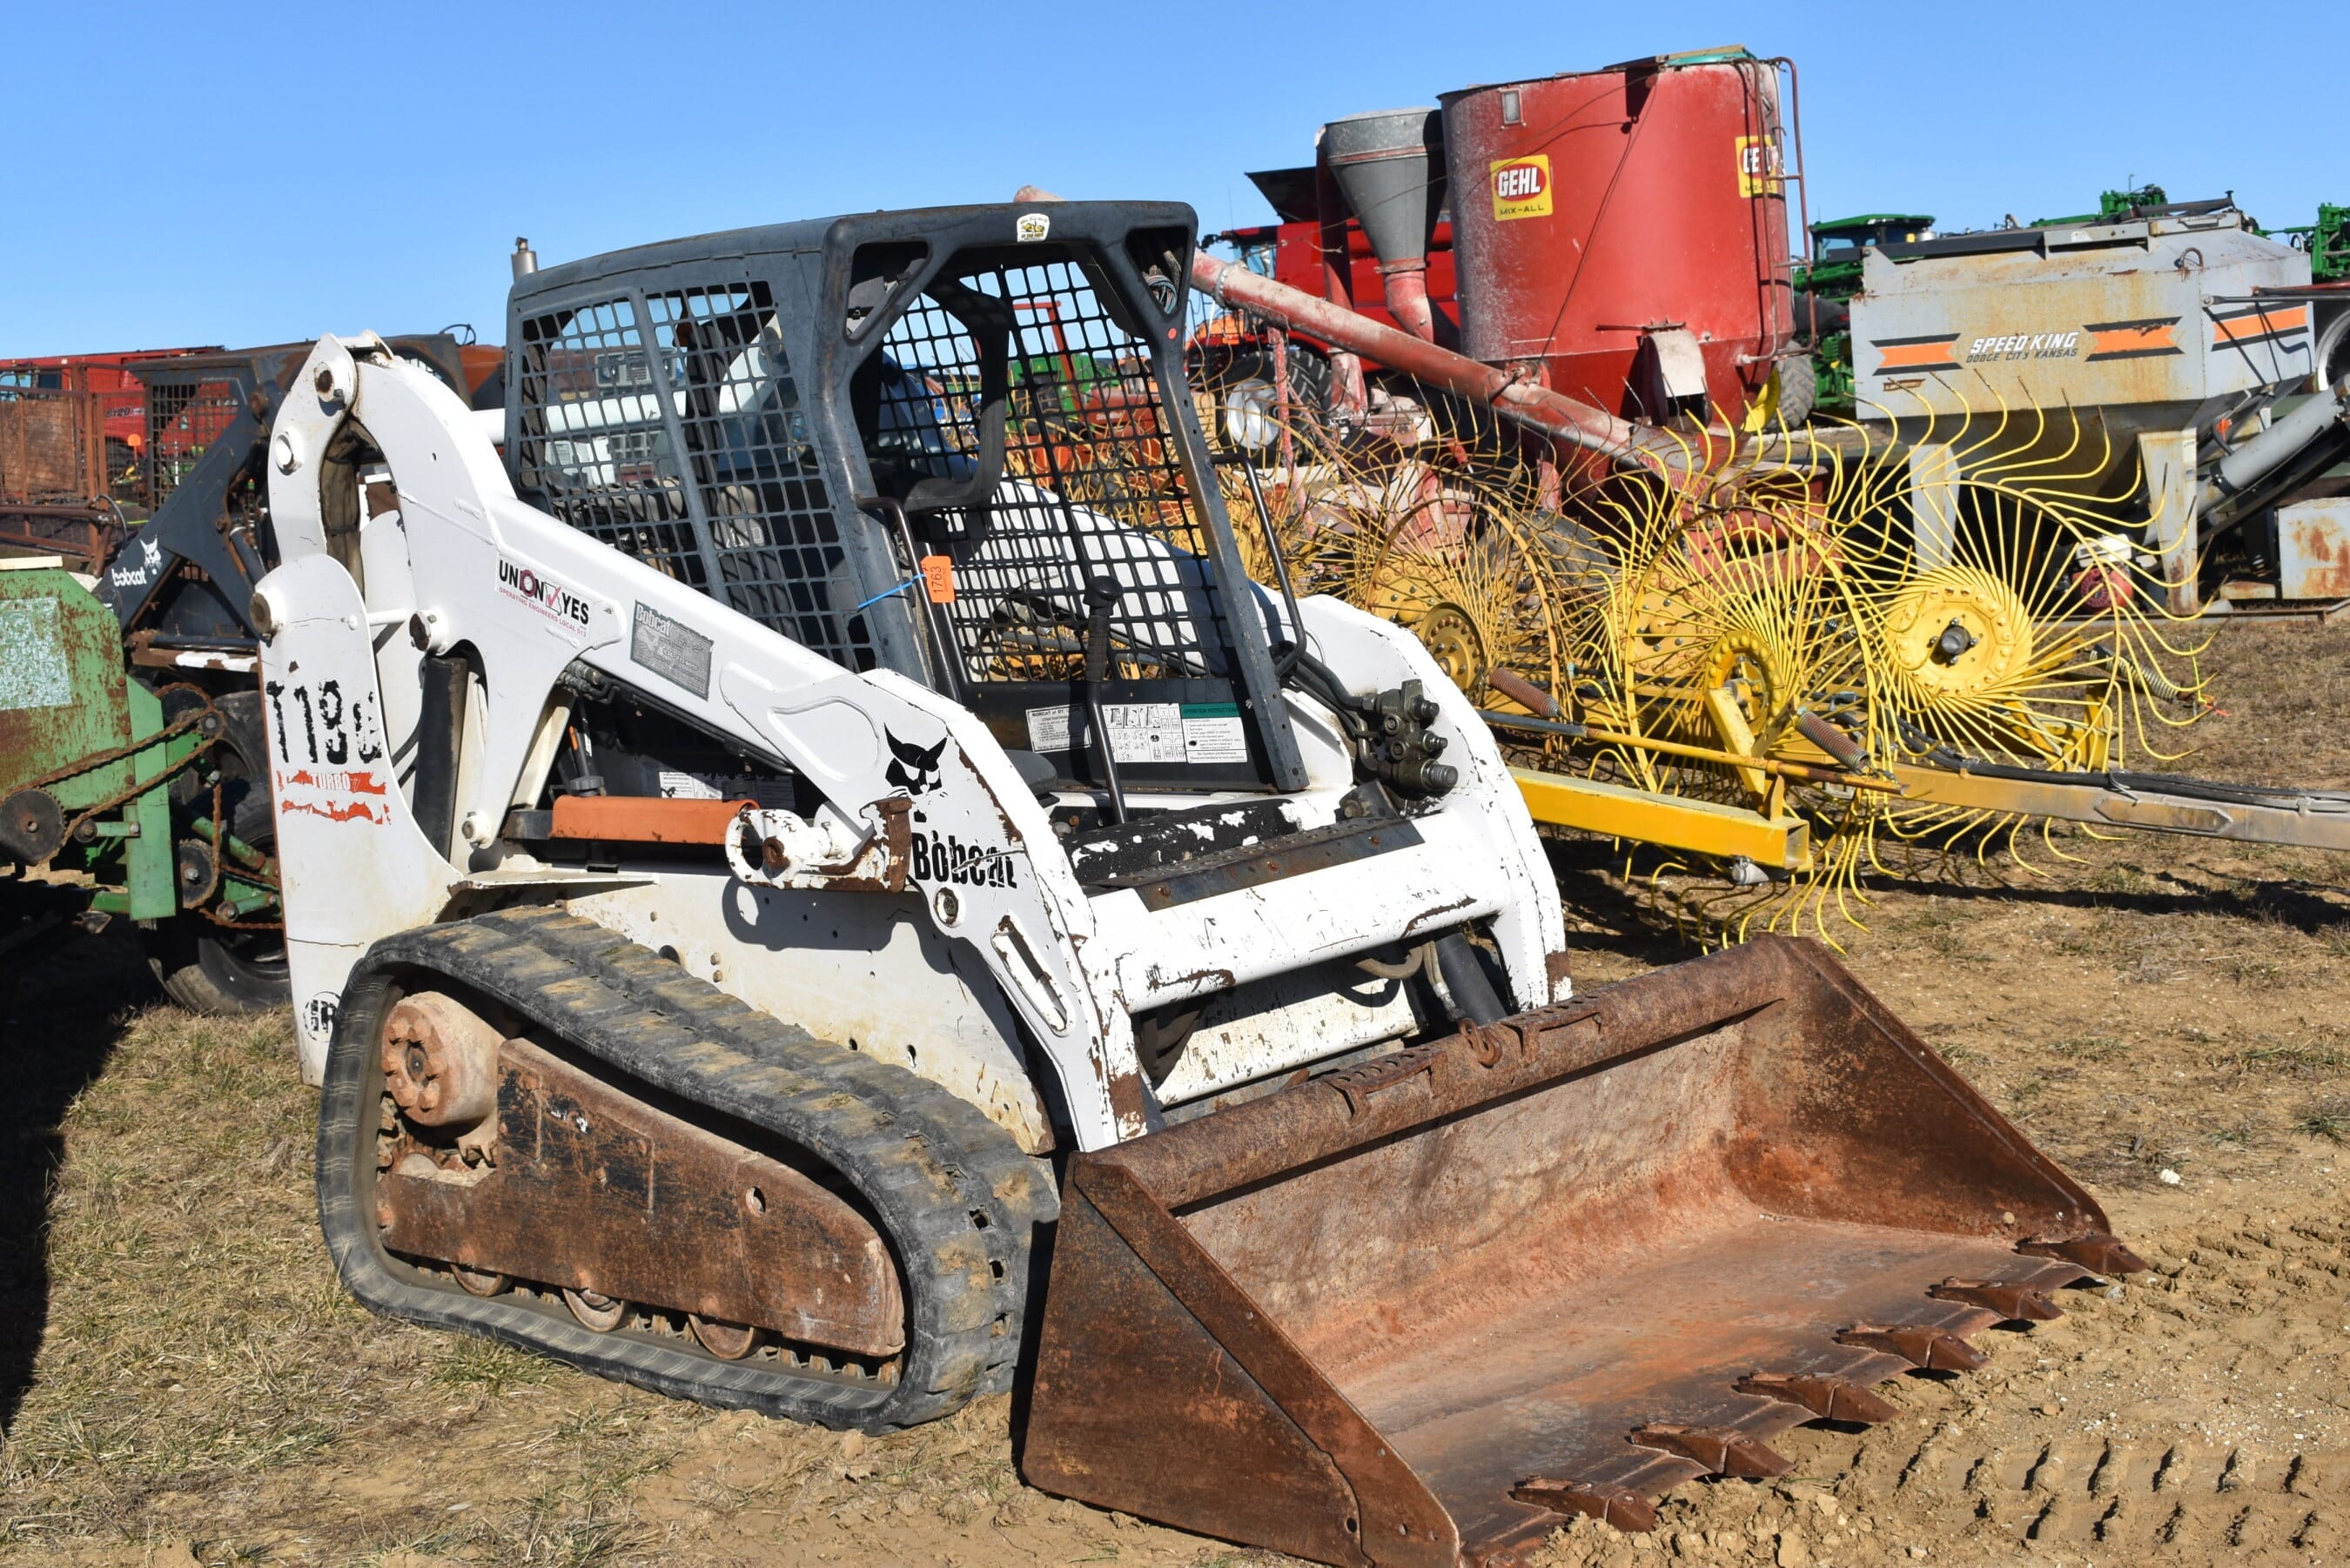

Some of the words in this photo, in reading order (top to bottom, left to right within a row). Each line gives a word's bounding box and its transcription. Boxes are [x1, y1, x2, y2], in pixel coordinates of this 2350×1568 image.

[1498, 166, 1541, 198] GEHL
[1500, 204, 1545, 215] MIX-ALL
[1966, 352, 2000, 363] DODGE
[2005, 352, 2030, 361] CITY
[2034, 348, 2078, 359] KANSAS
[1970, 335, 2029, 354] SPEED
[2030, 332, 2079, 351] KING
[111, 566, 146, 587] bobcat
[930, 566, 943, 593] 1763
[499, 586, 527, 606] OPERATING
[528, 603, 558, 623] ENGINEERS
[559, 620, 576, 632] LOCAL
[561, 592, 589, 626] YES
[634, 603, 674, 638] Bobcat
[312, 774, 351, 791] TURBO
[911, 832, 1017, 889] Bobcat
